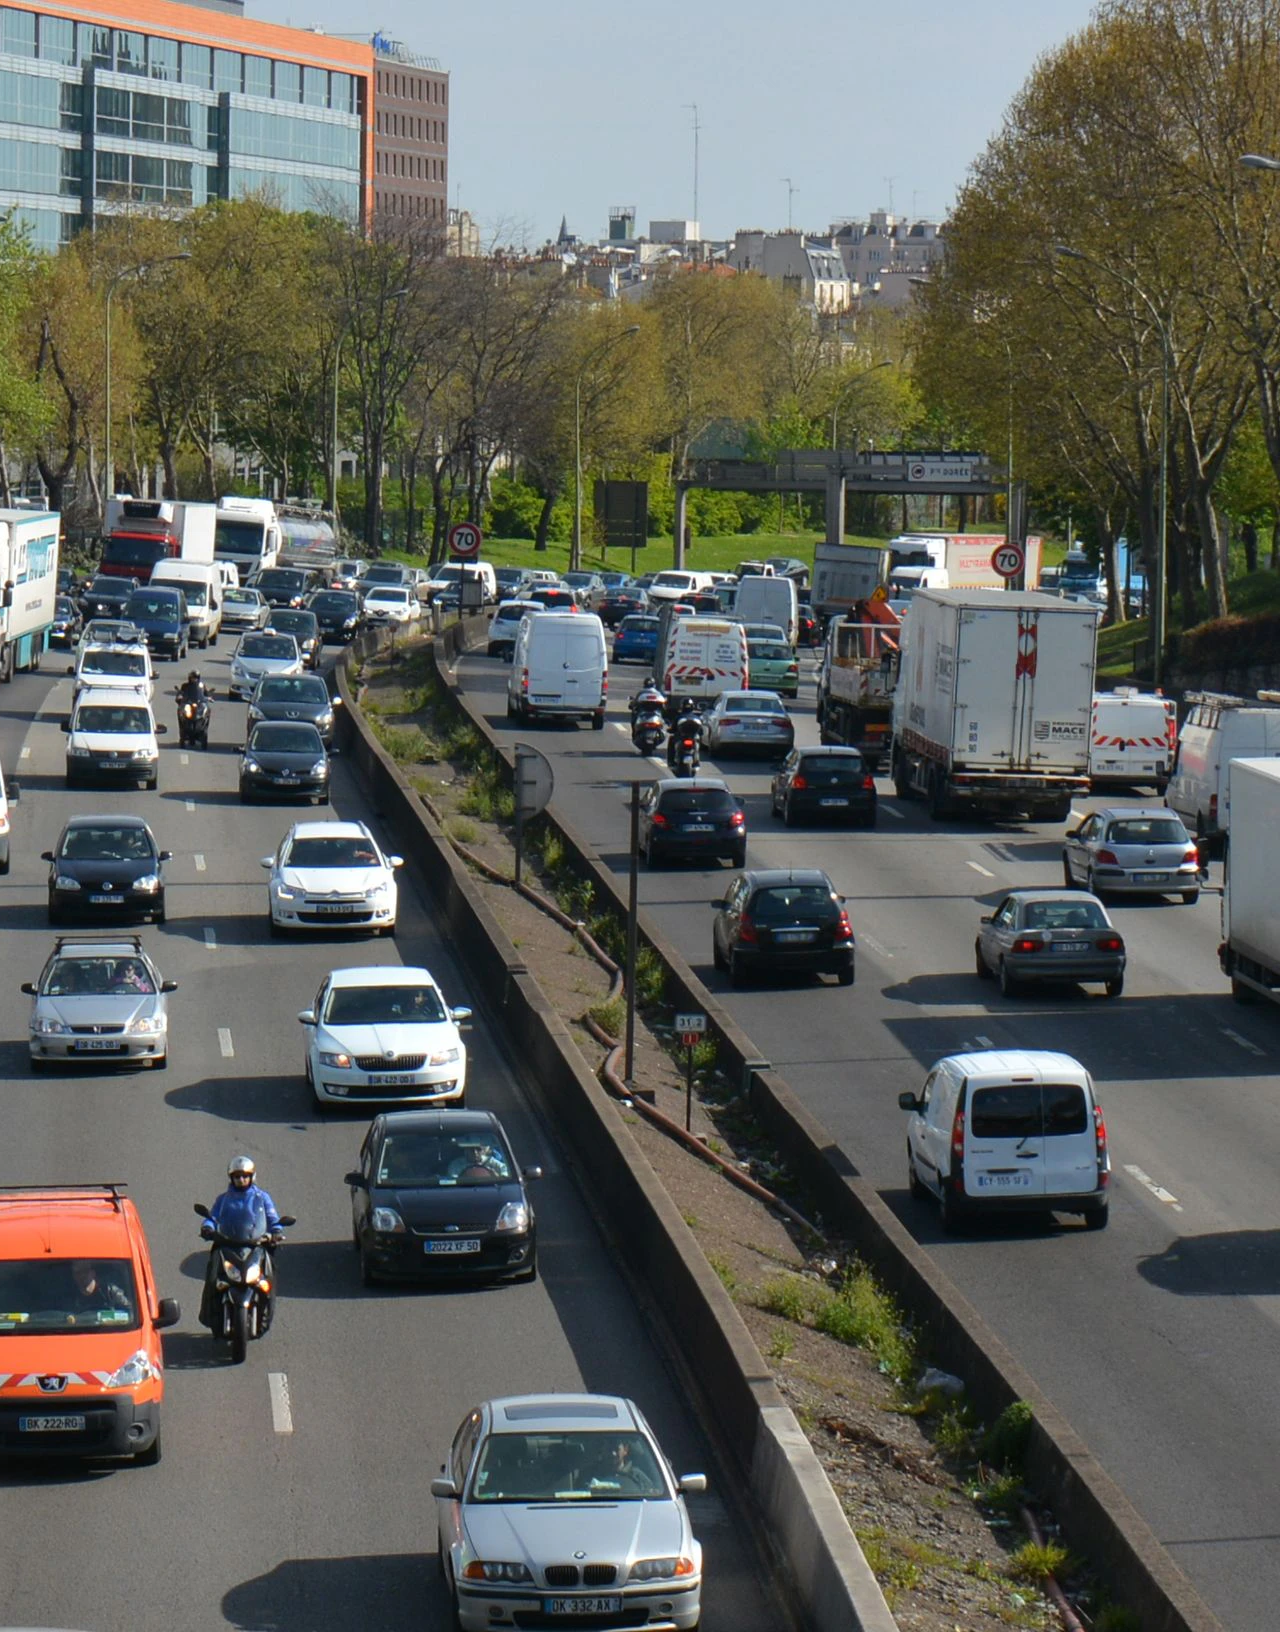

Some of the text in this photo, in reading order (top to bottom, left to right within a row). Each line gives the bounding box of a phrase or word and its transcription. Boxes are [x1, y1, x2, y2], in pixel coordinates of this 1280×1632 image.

[456, 532, 474, 546] 70
[999, 554, 1018, 567] 70
[1052, 726, 1086, 735] MACE
